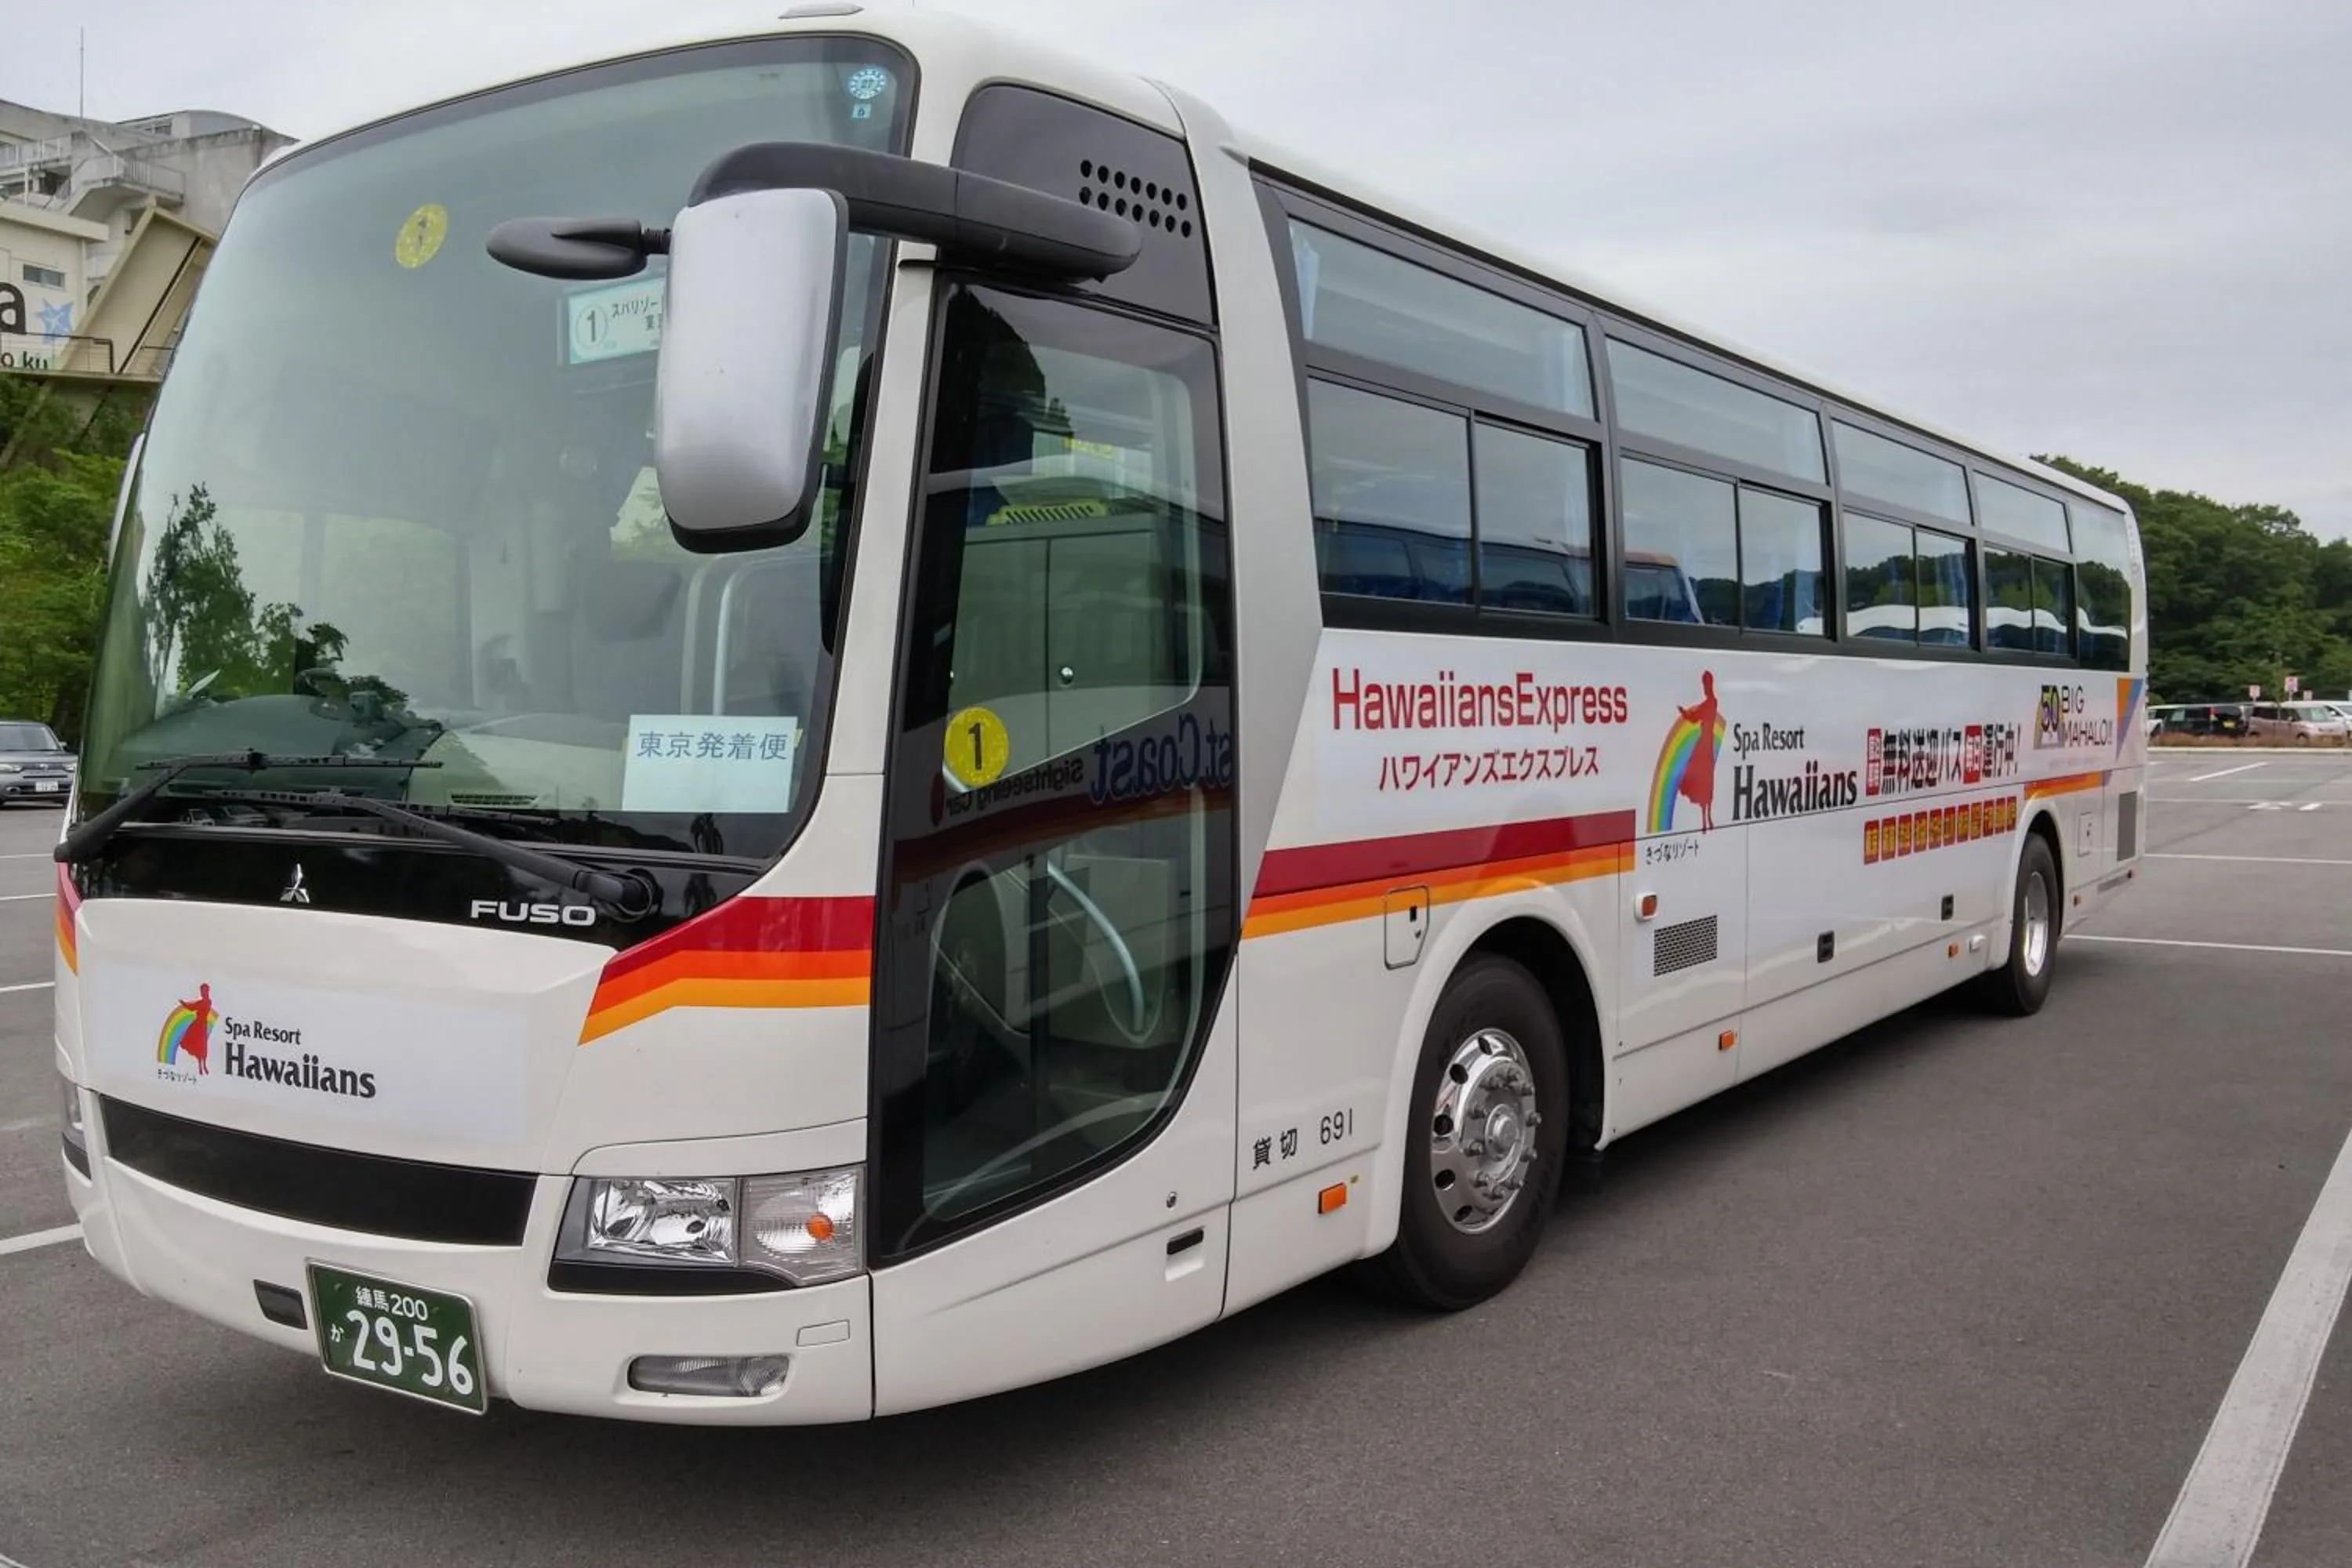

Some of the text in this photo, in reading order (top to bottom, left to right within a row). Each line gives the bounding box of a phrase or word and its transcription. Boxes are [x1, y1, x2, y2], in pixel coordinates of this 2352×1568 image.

[1332, 667, 1628, 732] HawaiiansExpress
[2061, 685, 2085, 714] BIG
[636, 730, 788, 760] 東京発着便
[967, 722, 982, 771] 1
[1733, 721, 1805, 760] Spa Resort
[1378, 746, 1599, 791] ハワイアンズエクスプレス
[1732, 760, 1857, 821] Hawaiians
[470, 899, 596, 927] FUSO
[224, 1017, 302, 1045] Spa Resort
[224, 1042, 376, 1098] Hawaiians
[1319, 1107, 1352, 1145] 691
[346, 1309, 474, 1396] 29-56
